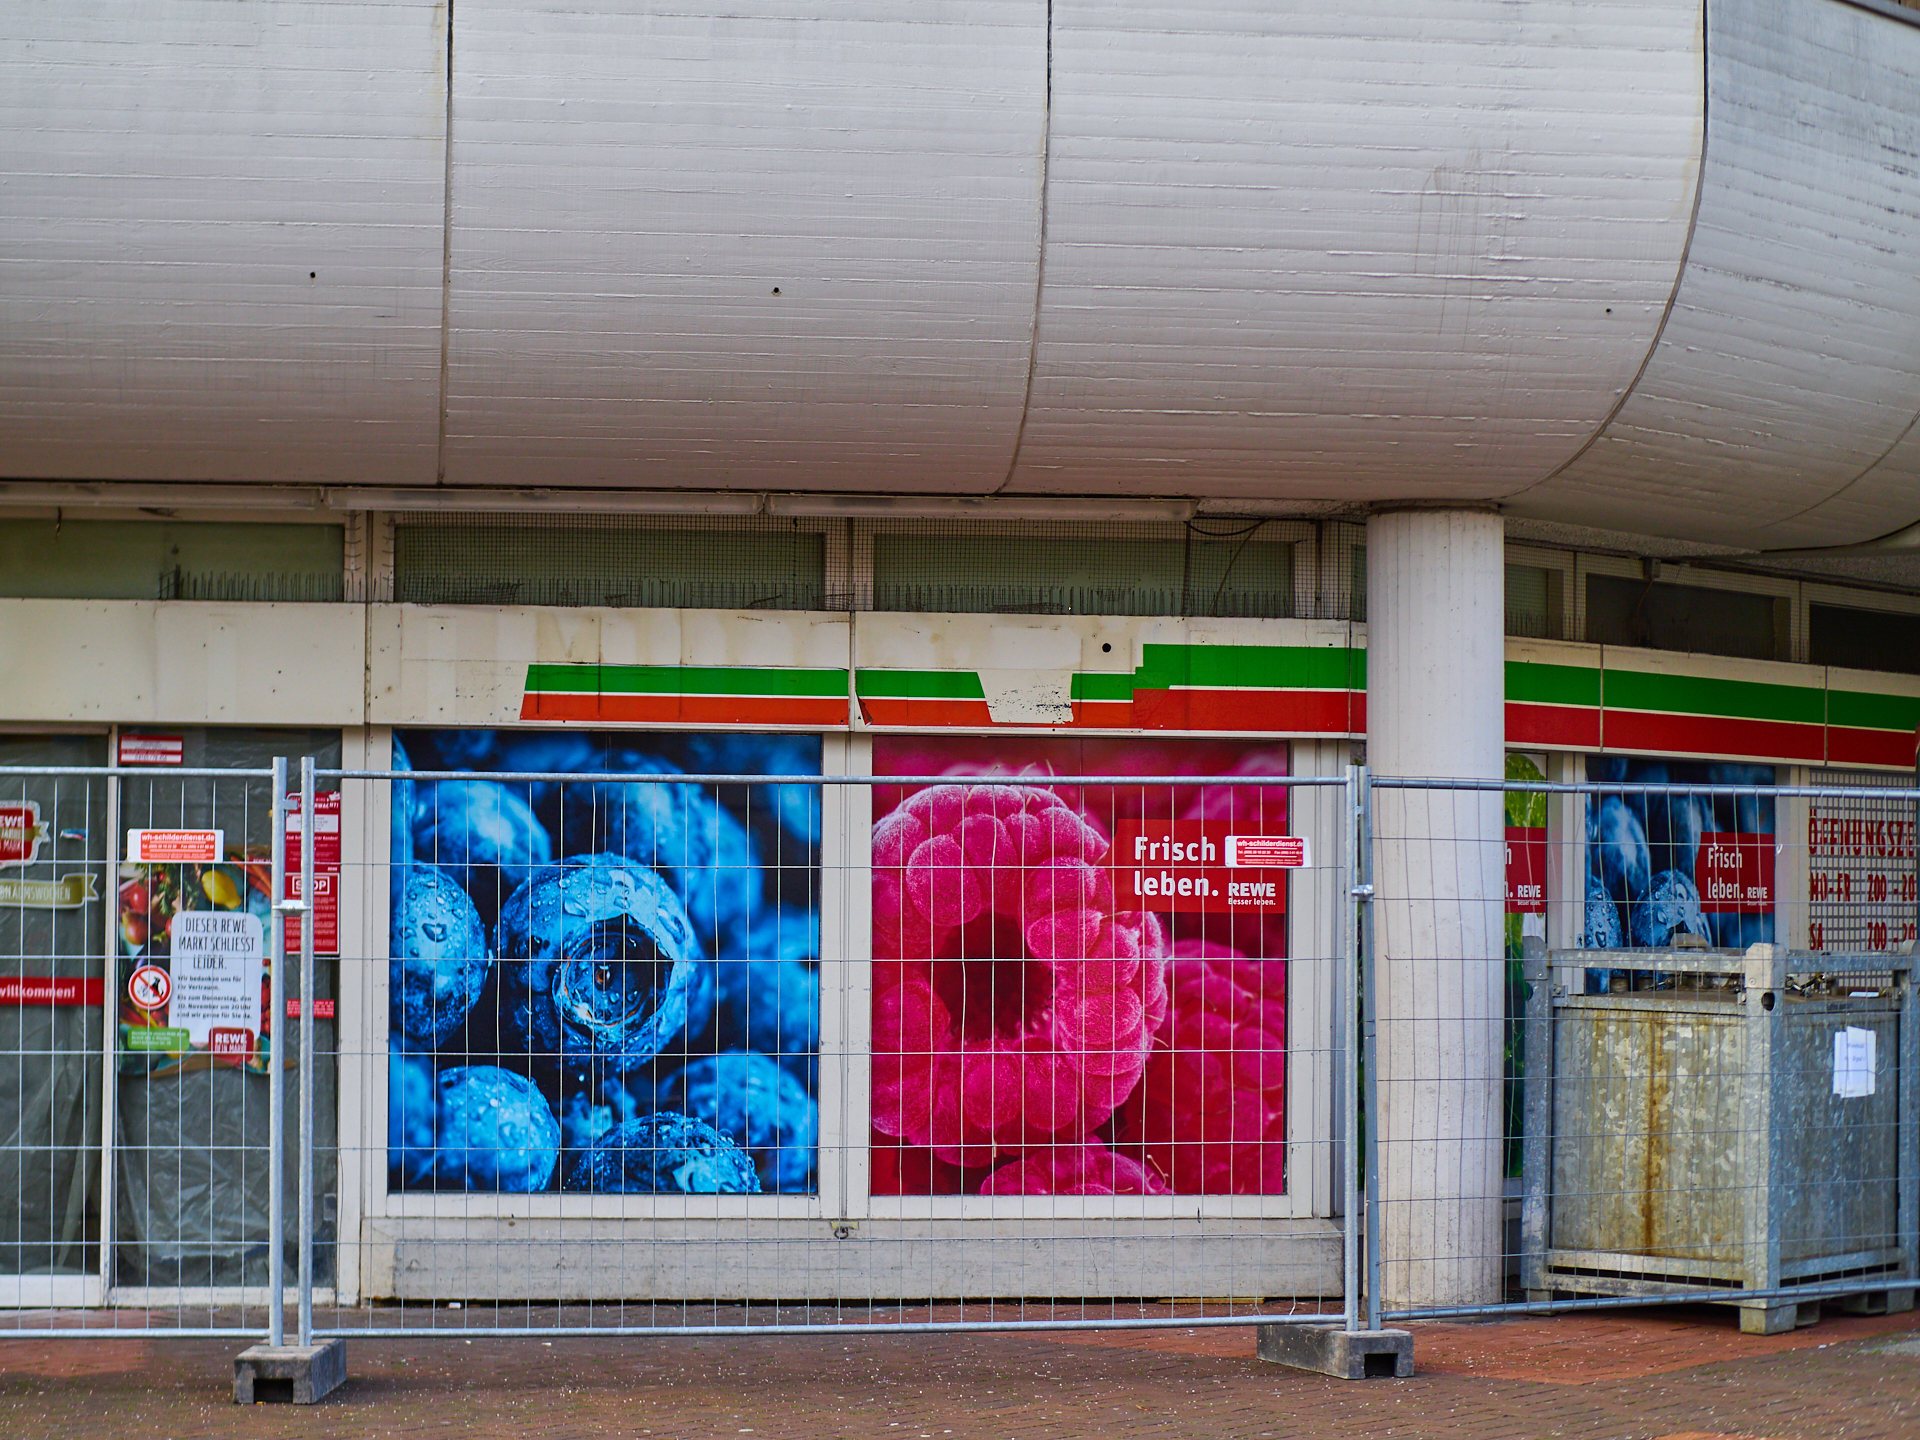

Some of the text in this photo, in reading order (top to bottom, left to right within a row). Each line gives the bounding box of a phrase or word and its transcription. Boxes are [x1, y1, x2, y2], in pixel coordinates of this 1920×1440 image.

[142, 833, 215, 841] wh-schilderdienst.de
[1134, 835, 1216, 861] Frisch
[1708, 846, 1743, 869] Frisch
[1134, 870, 1219, 896] leben.
[1228, 882, 1276, 897] REWE
[1517, 884, 1541, 898] REWE
[1707, 877, 1744, 899] leben.
[1747, 886, 1768, 899] REWE
[1228, 897, 1276, 906] Besser leben.
[185, 917, 247, 934] DIESER REWE
[178, 936, 255, 952] MARKT SCHLIESST
[1809, 922, 1824, 951] SA
[193, 954, 227, 970] LEIDER.
[201, 994, 239, 1002] Donnerstag,
[214, 1033, 248, 1044] REWE
